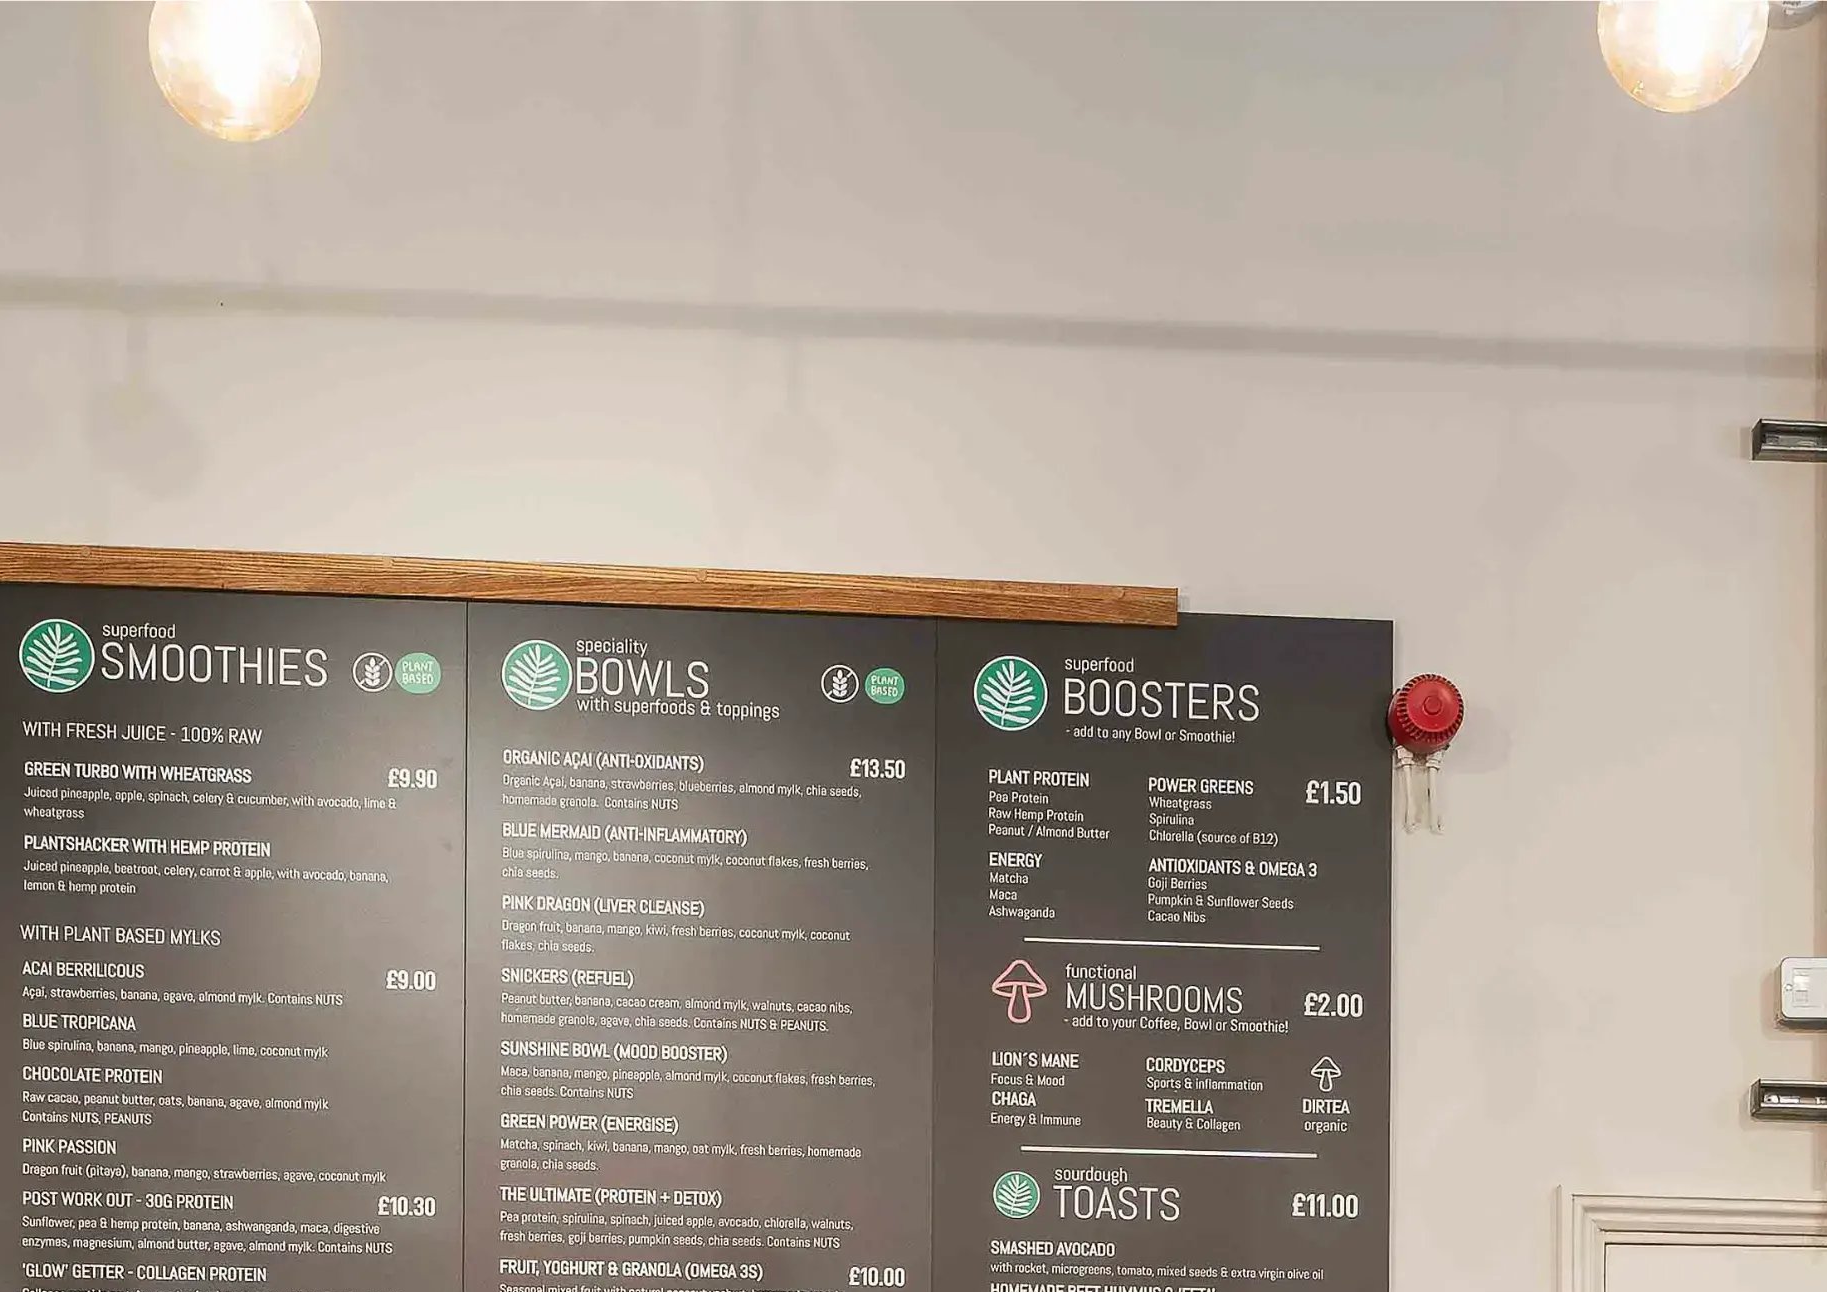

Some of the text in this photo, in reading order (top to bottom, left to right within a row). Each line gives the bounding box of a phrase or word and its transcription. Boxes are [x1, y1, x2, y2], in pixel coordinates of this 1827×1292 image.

[103, 623, 175, 640] superfood
[577, 638, 647, 657] speciality
[102, 642, 327, 686] SMOOTHIES
[1065, 657, 1133, 674] superfood
[577, 657, 708, 699] BOWLS
[577, 696, 779, 721] with superfoods & toppings
[1065, 678, 1259, 721] BOOSTERS
[504, 749, 560, 765] ORGANIC
[596, 752, 704, 773] (ANTI-OXIDANTS)
[850, 759, 905, 778] £13.50
[25, 762, 251, 783] GREEN TURBO WITH WHEATGRASS
[388, 768, 437, 788] £9.90
[989, 769, 1089, 786] PLANT PROTEIN
[1149, 777, 1253, 794] POWER GREENS
[1306, 780, 1360, 804] £1.50
[990, 852, 1042, 867] ENERGY
[502, 968, 633, 989] SNICKERS (REFUEL)
[1066, 963, 1136, 979] functional
[1067, 983, 1242, 1013] MUSHROOMS
[1304, 993, 1362, 1017] £2.00
[1147, 1058, 1225, 1073] CORDYCEPS
[992, 1091, 1036, 1106] CHAGA
[1303, 1099, 1350, 1113] DIRTEA
[1305, 1119, 1347, 1134] organic
[23, 1139, 116, 1154] PINK PASSION
[1055, 1167, 1127, 1185] sourdough
[378, 1196, 435, 1216] £10.30
[1053, 1186, 1179, 1220] TOASTS
[1292, 1193, 1358, 1217] £11.00
[991, 1241, 1115, 1256] SMASHED AVOCADO
[849, 1267, 904, 1286] £10.00
